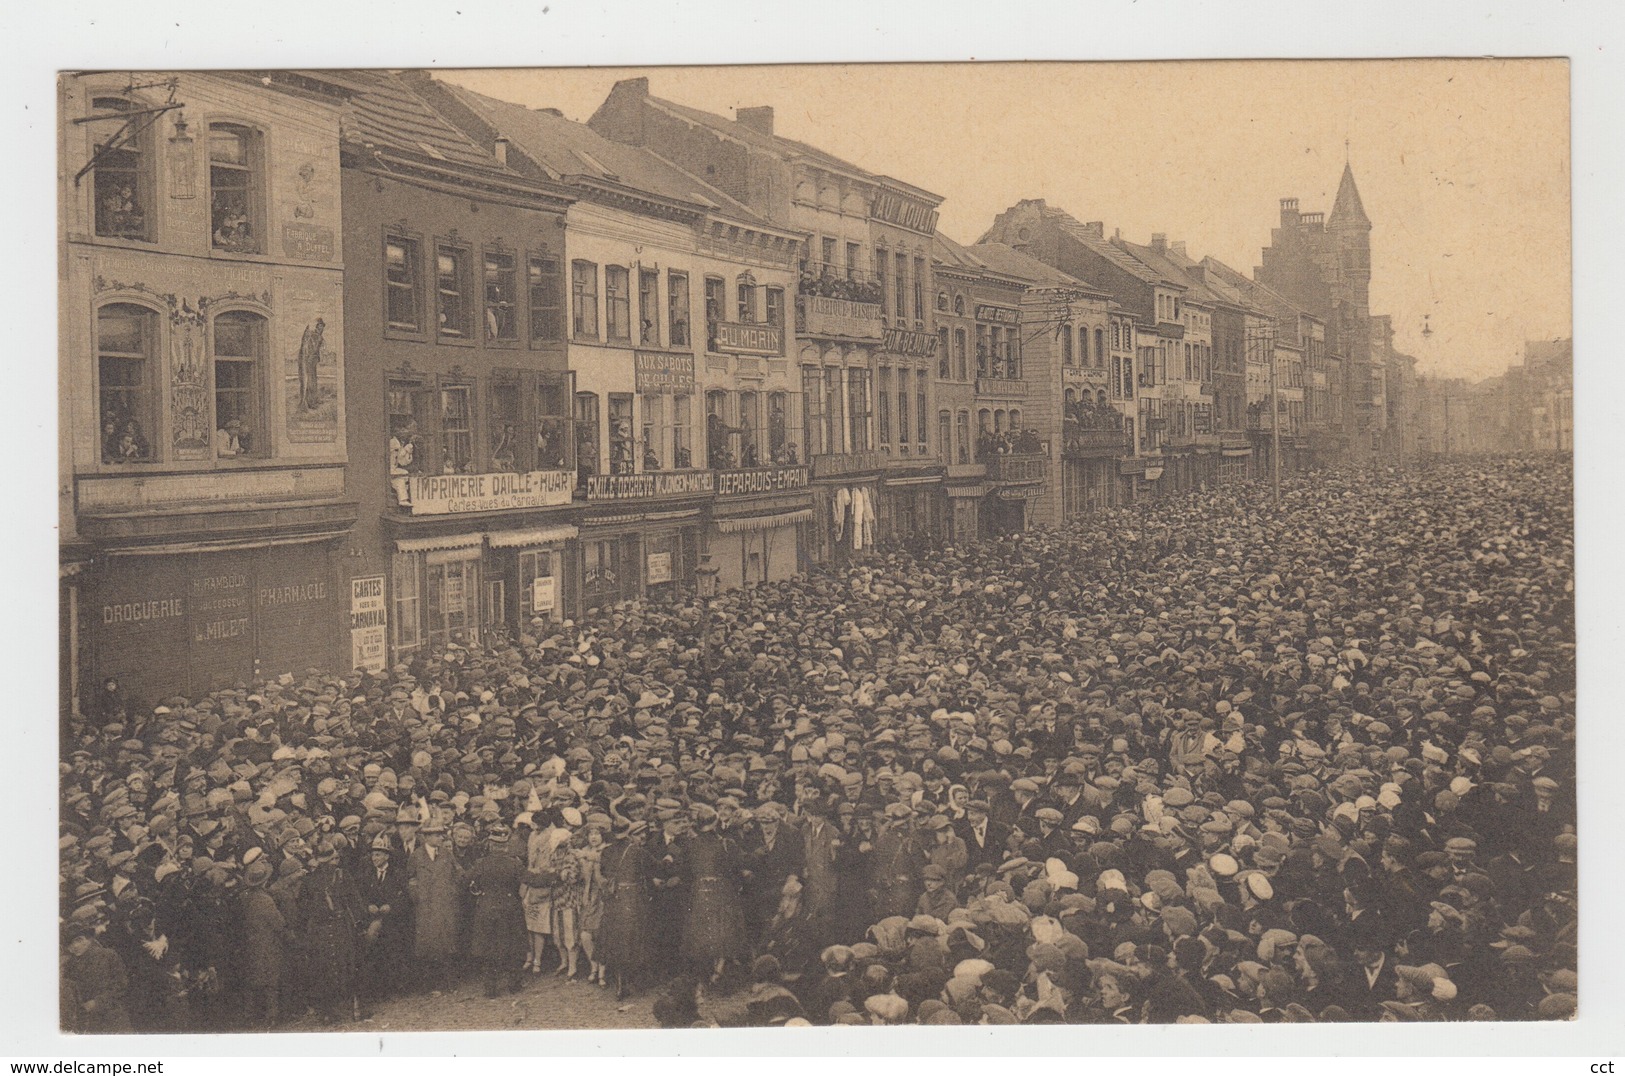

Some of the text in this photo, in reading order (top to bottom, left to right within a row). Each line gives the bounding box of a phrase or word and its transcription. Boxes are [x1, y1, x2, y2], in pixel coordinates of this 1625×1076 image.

[876, 194, 938, 234] AU MOULIN
[810, 297, 847, 317] FABRIQUE
[720, 326, 779, 349] AU MARIN
[638, 354, 692, 372] AUX SABOTS
[638, 373, 692, 389] DE GILLES
[416, 476, 486, 500] IMPRIMERIE
[587, 475, 653, 499] EMILE DEGREVE
[719, 467, 809, 495] DEPARADIS-EMPAIN
[500, 497, 510, 507] du
[511, 493, 549, 509] Carnaval
[260, 581, 327, 607] PHARMACIE
[354, 580, 382, 599] CARTES
[103, 598, 184, 625] DROGUERIE
[350, 608, 386, 630] CARNAVAL
